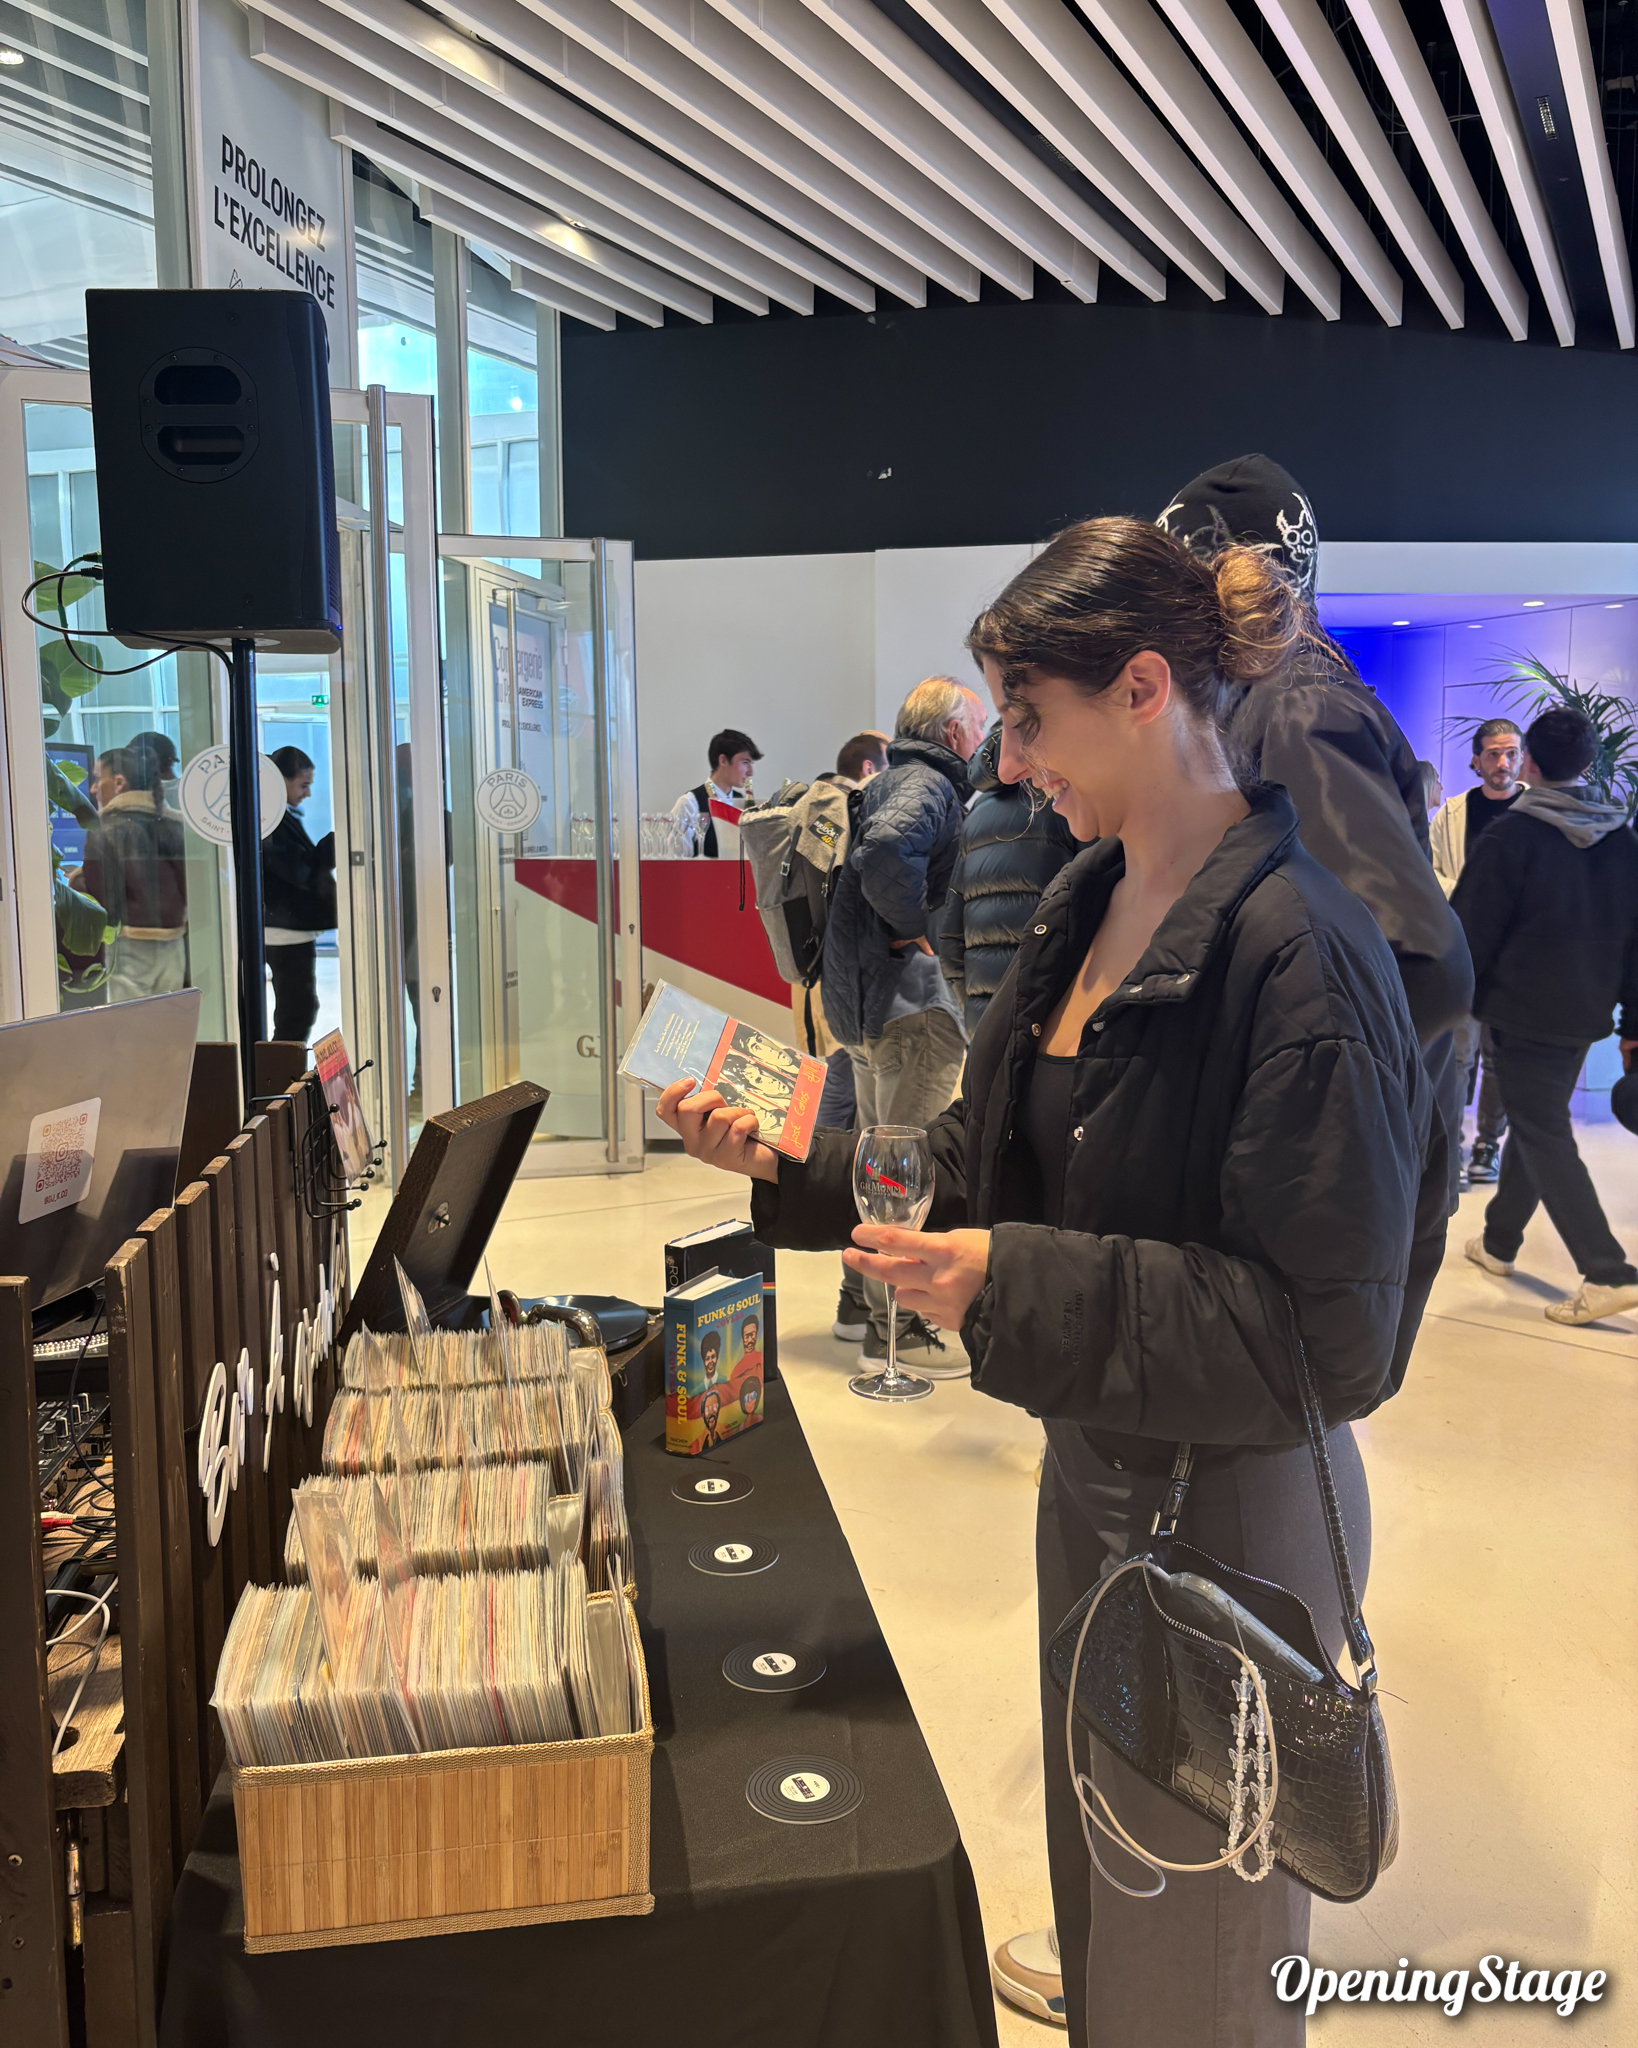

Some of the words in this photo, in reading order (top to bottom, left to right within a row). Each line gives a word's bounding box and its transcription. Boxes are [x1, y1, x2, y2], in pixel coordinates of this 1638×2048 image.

[222, 134, 326, 252] PROLONGEZ
[214, 184, 335, 309] L'EXCELLENCE
[518, 687, 543, 699] AMERICAN
[521, 697, 544, 709] EXPRESS
[487, 773, 528, 788] PARIS
[697, 1306, 727, 1328] FUNK
[726, 1303, 736, 1316] &
[735, 1293, 761, 1312] SOUL
[715, 1311, 744, 1329] COVERS
[676, 1323, 687, 1367] FUNK
[676, 1369, 687, 1384] &
[677, 1385, 688, 1425] SOUL
